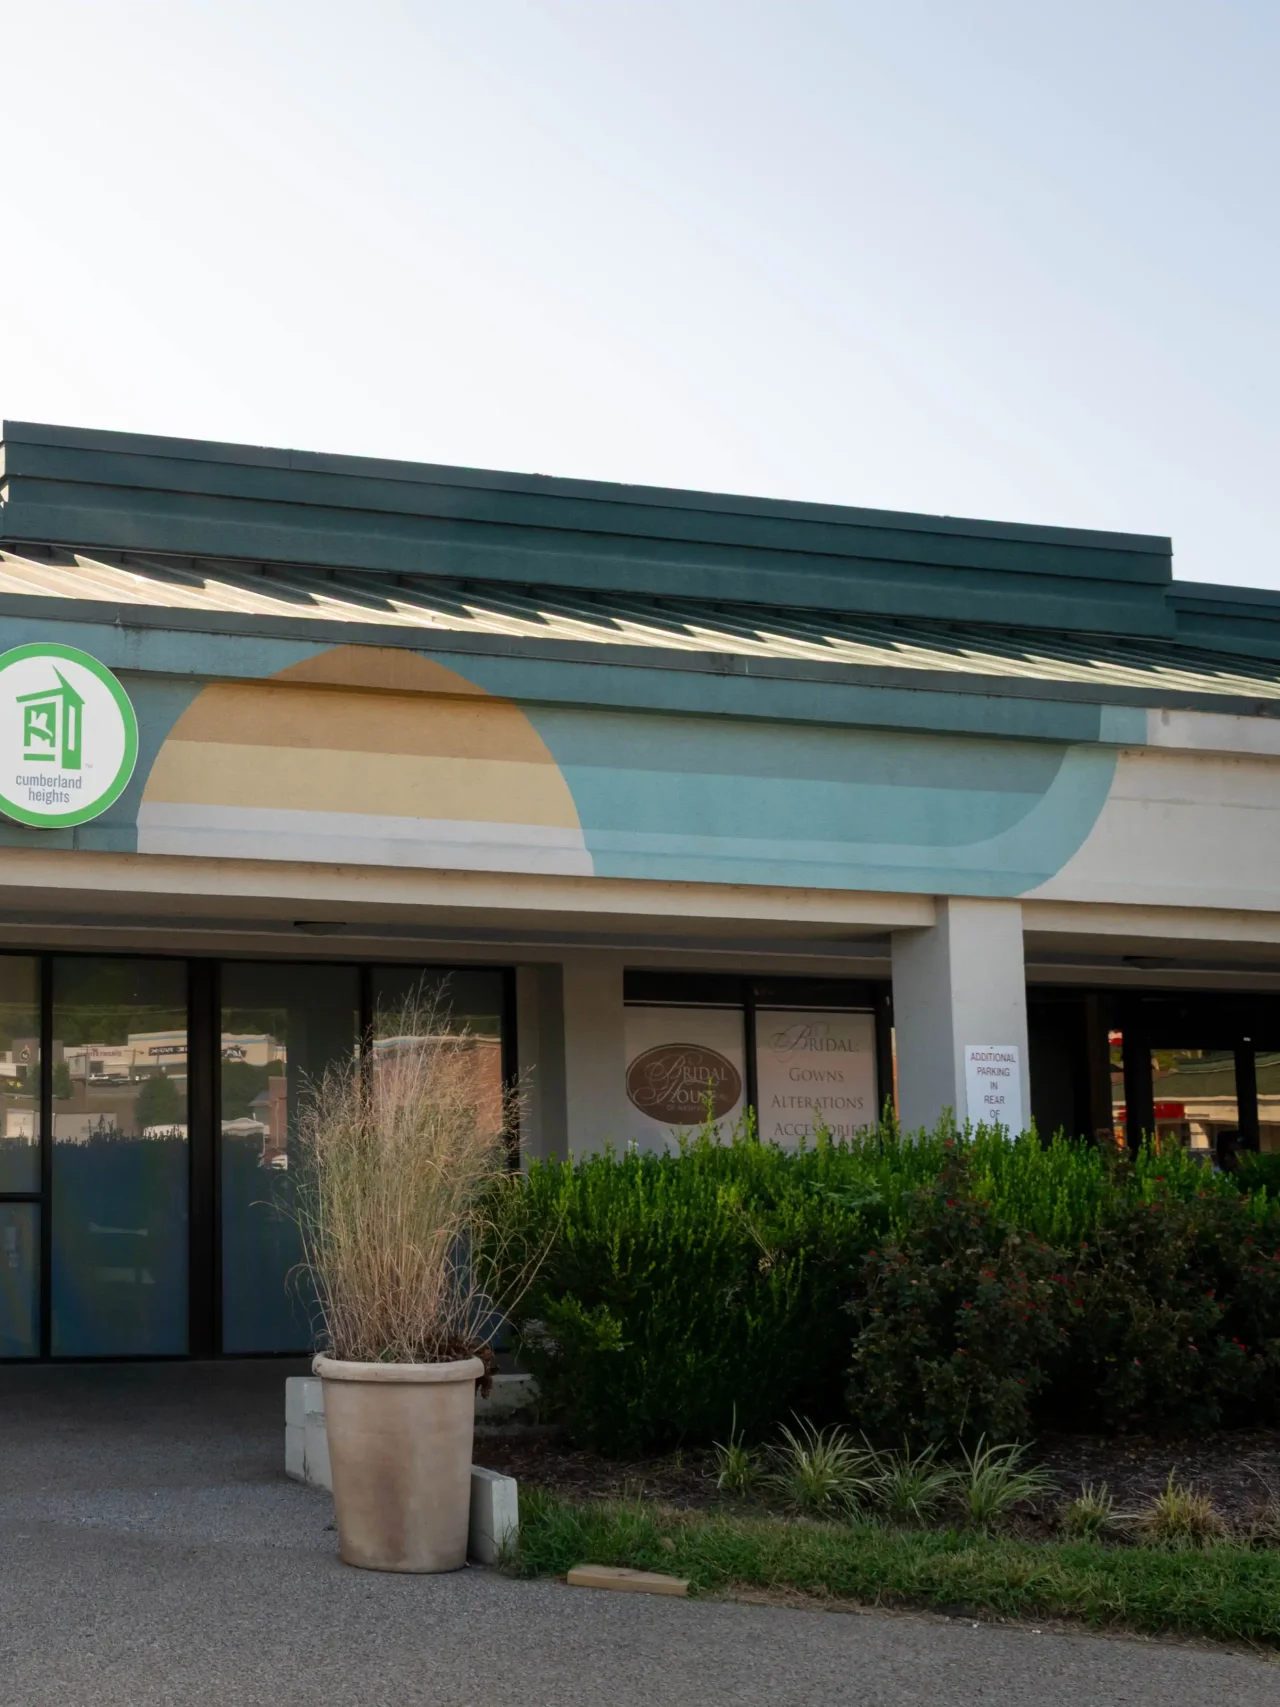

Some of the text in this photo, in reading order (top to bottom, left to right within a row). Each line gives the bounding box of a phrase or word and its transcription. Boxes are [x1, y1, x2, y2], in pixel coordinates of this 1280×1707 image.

[16, 773, 82, 789] cumberland
[28, 788, 70, 805] heights
[970, 1052, 1017, 1063] ADDITIONAL
[644, 1051, 728, 1082] BRIDAL
[976, 1066, 1011, 1077] PARKING
[789, 1067, 845, 1083] GOWNS
[990, 1081, 998, 1090] IN
[771, 1093, 864, 1110] ALTERATIONS
[984, 1095, 1005, 1104] REAR
[989, 1109, 1000, 1118] OF
